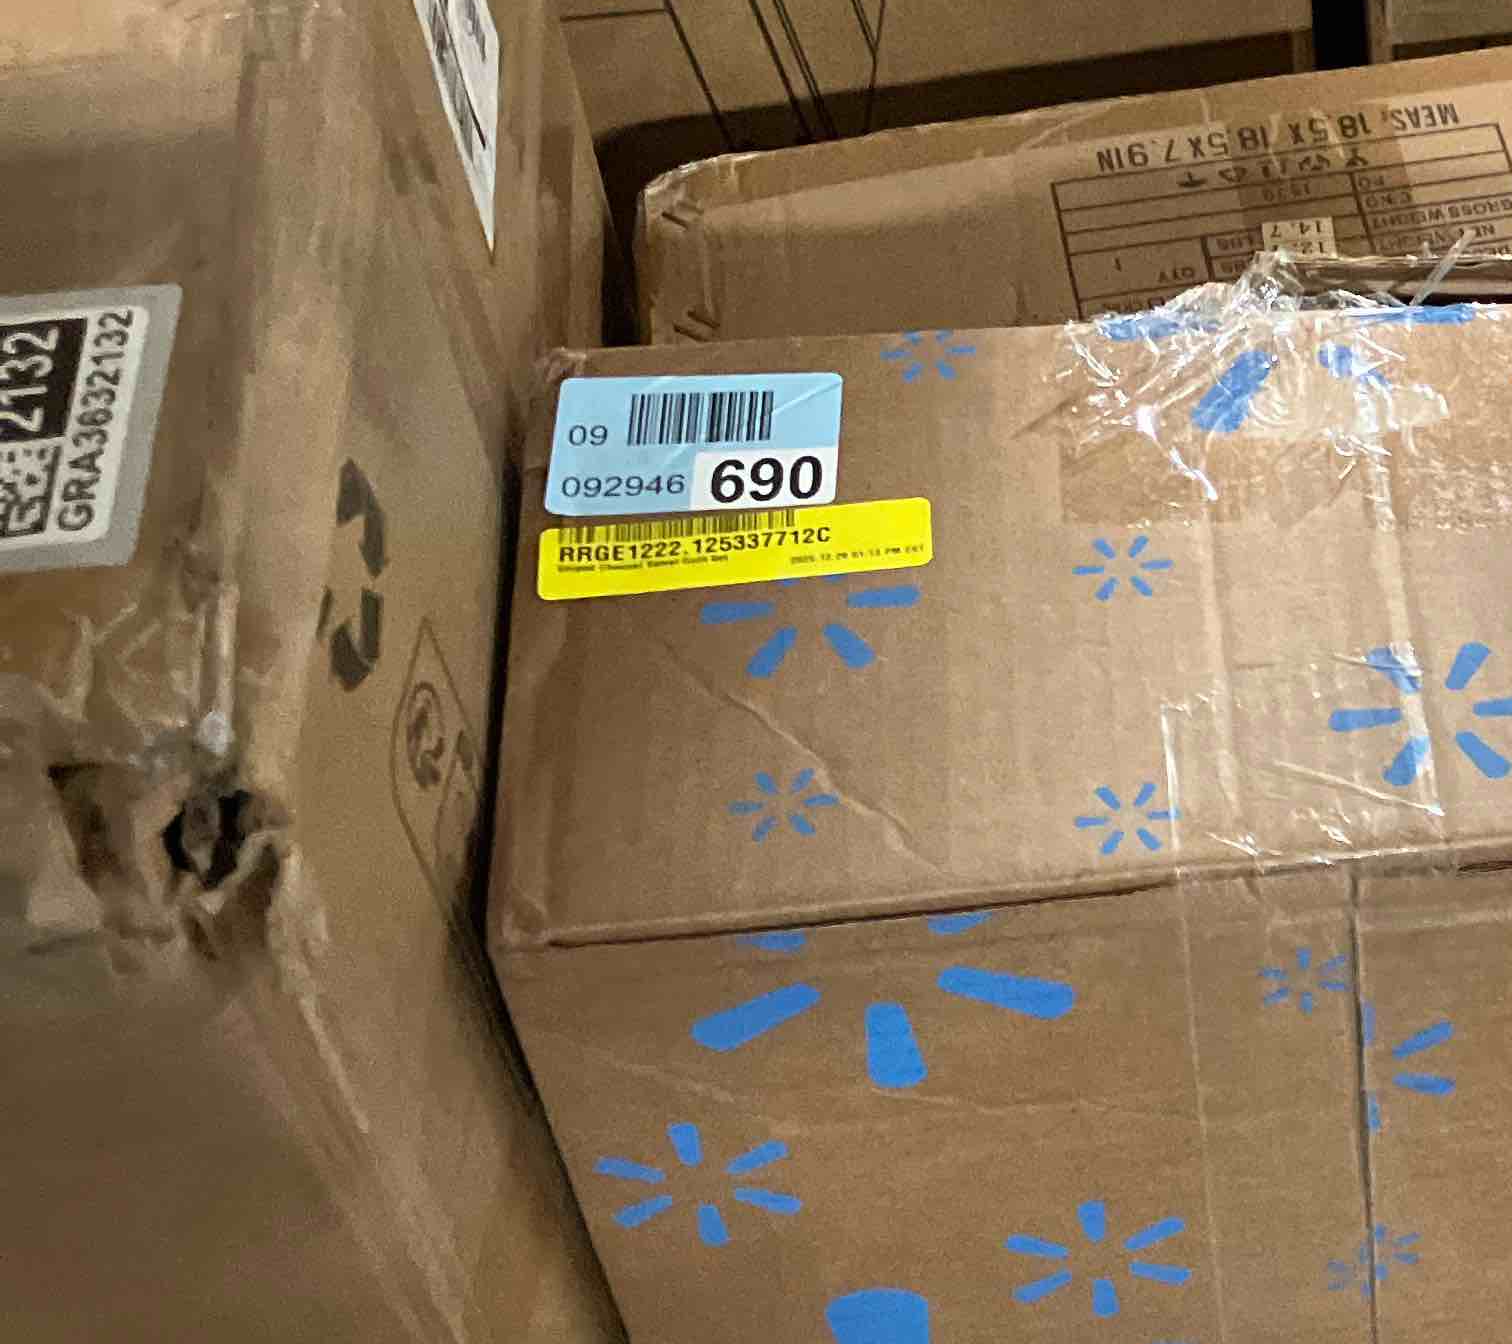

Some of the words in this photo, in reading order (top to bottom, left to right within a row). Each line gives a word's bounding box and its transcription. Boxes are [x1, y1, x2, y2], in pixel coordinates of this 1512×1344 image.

[1447, 198, 1512, 218] GROSS
[0, 328, 59, 432] 2132
[56, 309, 134, 532] GRA3632132
[568, 424, 607, 446] 09
[561, 473, 685, 498] 092946
[709, 454, 823, 504] 690
[558, 526, 832, 563] RRGE1222.125337712C
